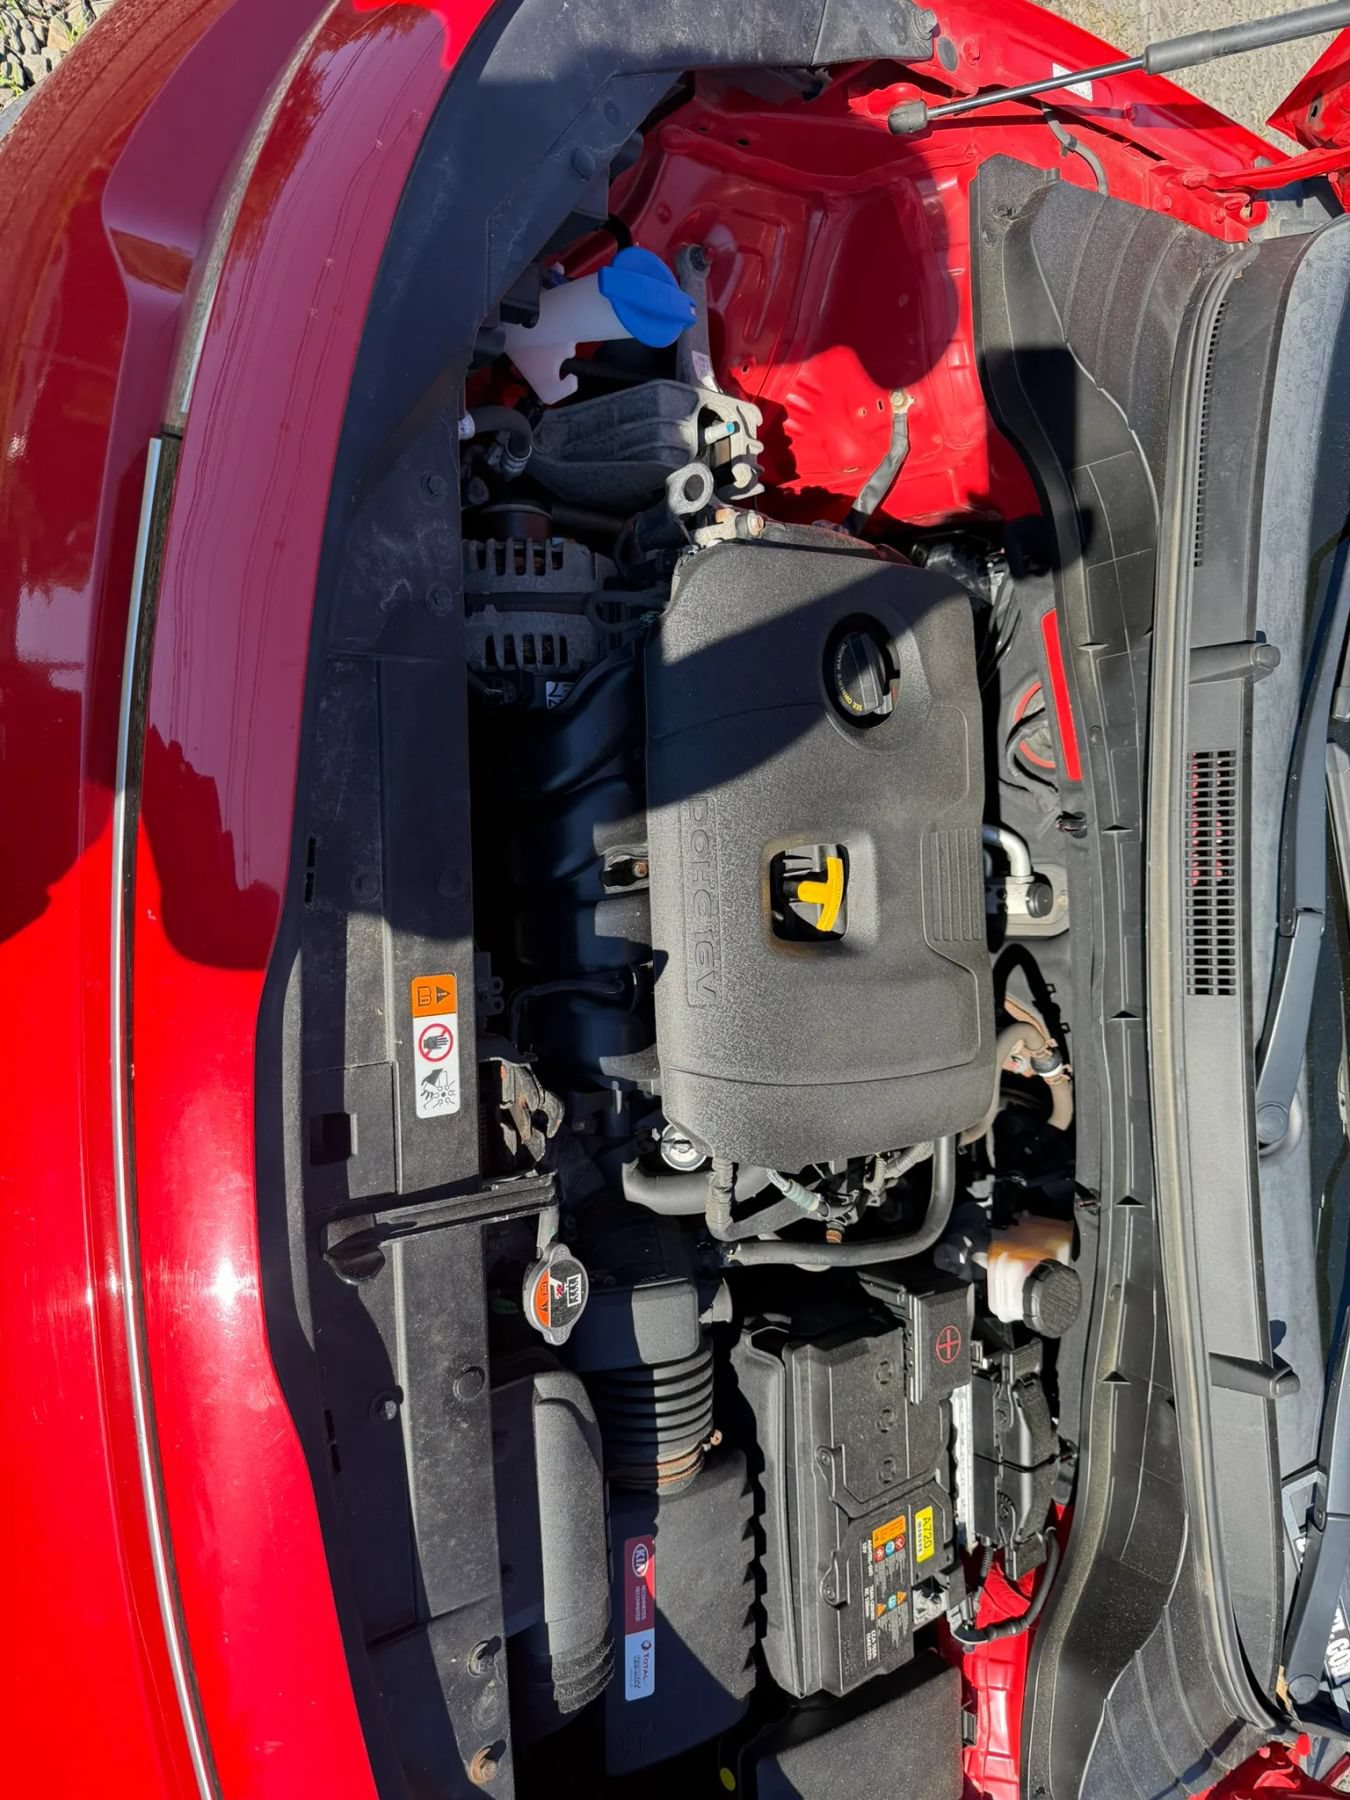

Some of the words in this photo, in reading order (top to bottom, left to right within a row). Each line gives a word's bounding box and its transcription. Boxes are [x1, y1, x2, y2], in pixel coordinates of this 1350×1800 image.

[689, 799, 711, 918] DOHC
[694, 929, 716, 999] 16V
[923, 1517, 932, 1549] A720
[635, 1549, 645, 1574] KIA
